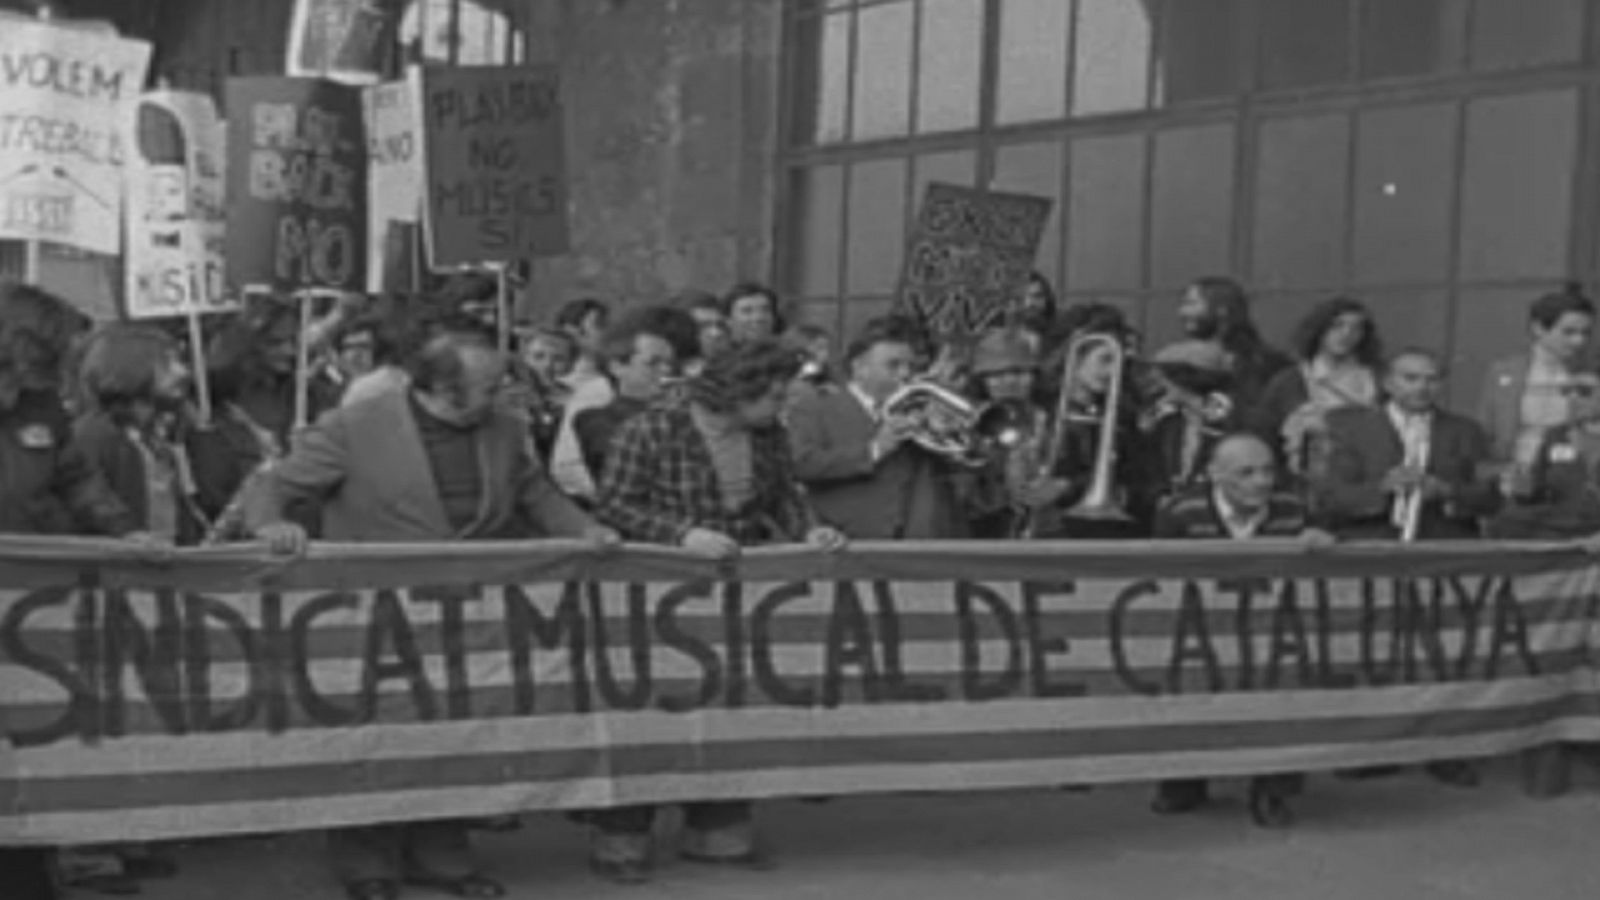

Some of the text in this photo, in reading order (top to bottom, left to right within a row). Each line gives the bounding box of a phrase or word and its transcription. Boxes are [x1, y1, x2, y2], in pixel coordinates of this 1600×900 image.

[2, 53, 123, 100] VOLEM
[275, 215, 353, 286] NO
[2, 566, 1541, 747] SINDICAT MUSICAL DE CATALUNYA
